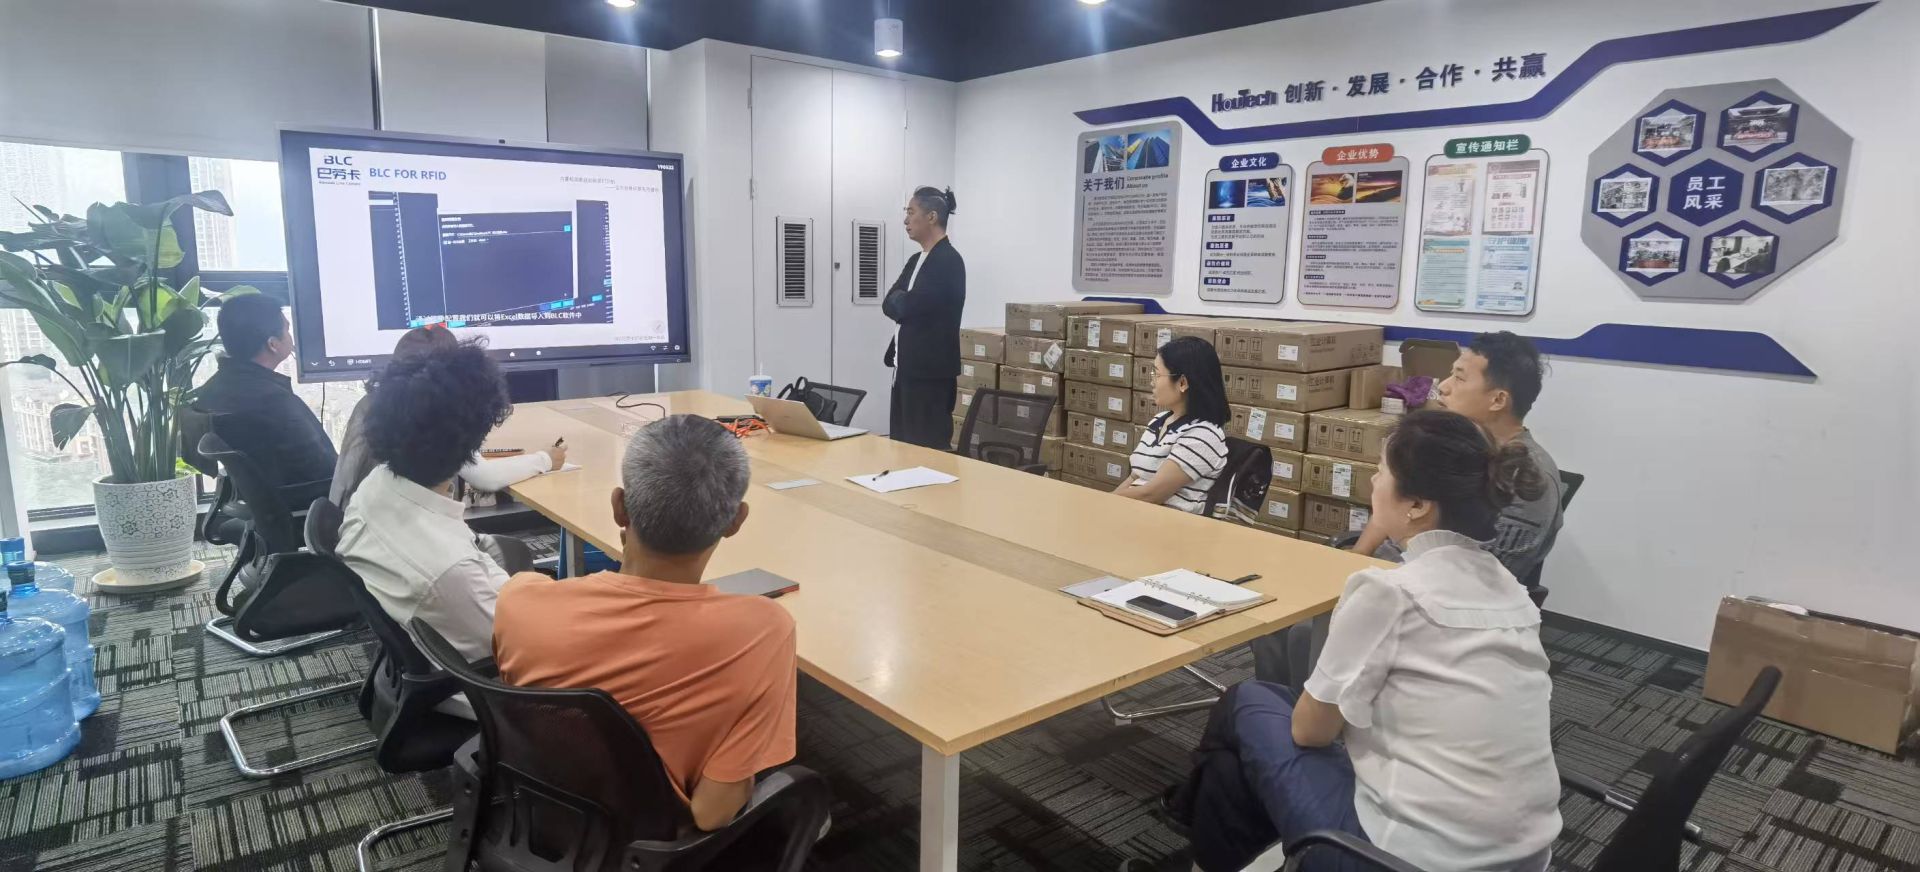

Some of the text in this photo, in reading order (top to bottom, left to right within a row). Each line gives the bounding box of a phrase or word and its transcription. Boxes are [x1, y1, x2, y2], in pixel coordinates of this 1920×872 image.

[1455, 138, 1519, 154] 宣传通知栏
[323, 155, 353, 166] BLC
[1336, 148, 1379, 161] 企业优势
[1231, 156, 1267, 169] 企业文化
[317, 167, 361, 180] 巴劳卡
[369, 167, 447, 181] BLC FOR RFID
[1083, 176, 1125, 192] 关于我们
[1687, 176, 1726, 192] 员工
[1683, 194, 1724, 210] 风采
